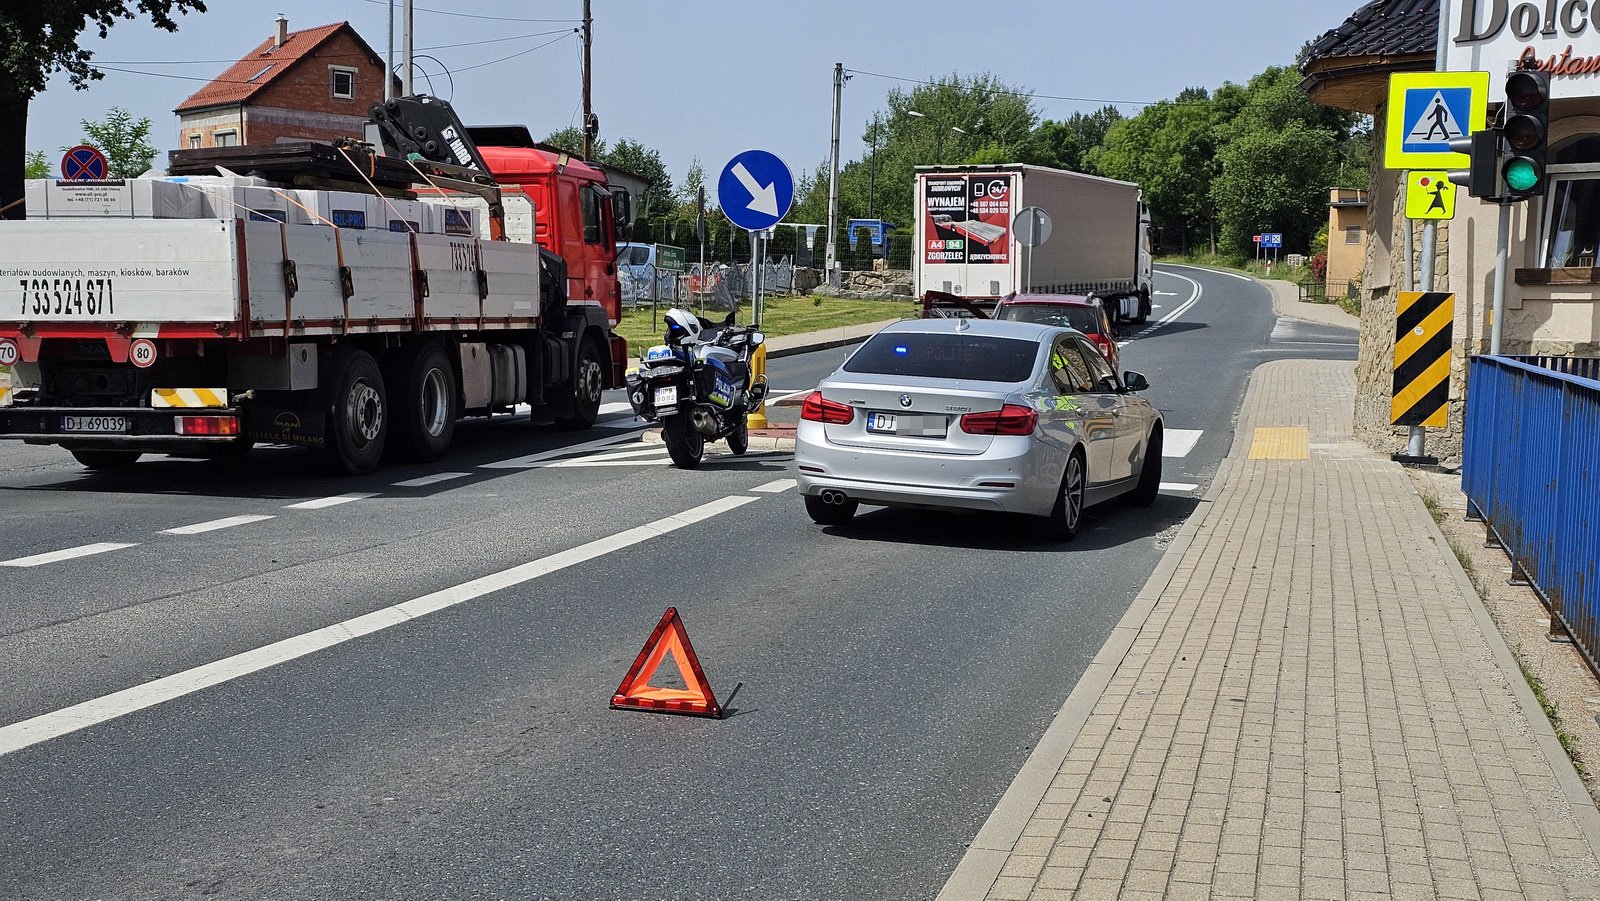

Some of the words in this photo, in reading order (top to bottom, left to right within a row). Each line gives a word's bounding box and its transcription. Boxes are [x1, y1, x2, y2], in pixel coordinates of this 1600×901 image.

[1453, 0, 1600, 42] Dolc
[450, 138, 471, 165] HIAB
[991, 186, 1008, 194] 24/7
[927, 196, 965, 207] WYNAJEM
[334, 213, 365, 227] SIL-PRO
[927, 251, 964, 260] ZGORZELEC
[32, 268, 85, 279] budowlanych,
[87, 269, 118, 278] maszyn,
[120, 268, 154, 277] kiosków,
[155, 267, 190, 276] baraków
[0, 346, 14, 359] 70
[136, 347, 149, 360] 80
[66, 417, 82, 431] DJ
[88, 417, 124, 431] 69039
[877, 414, 895, 430] DJ
[293, 434, 325, 444] MILANO
